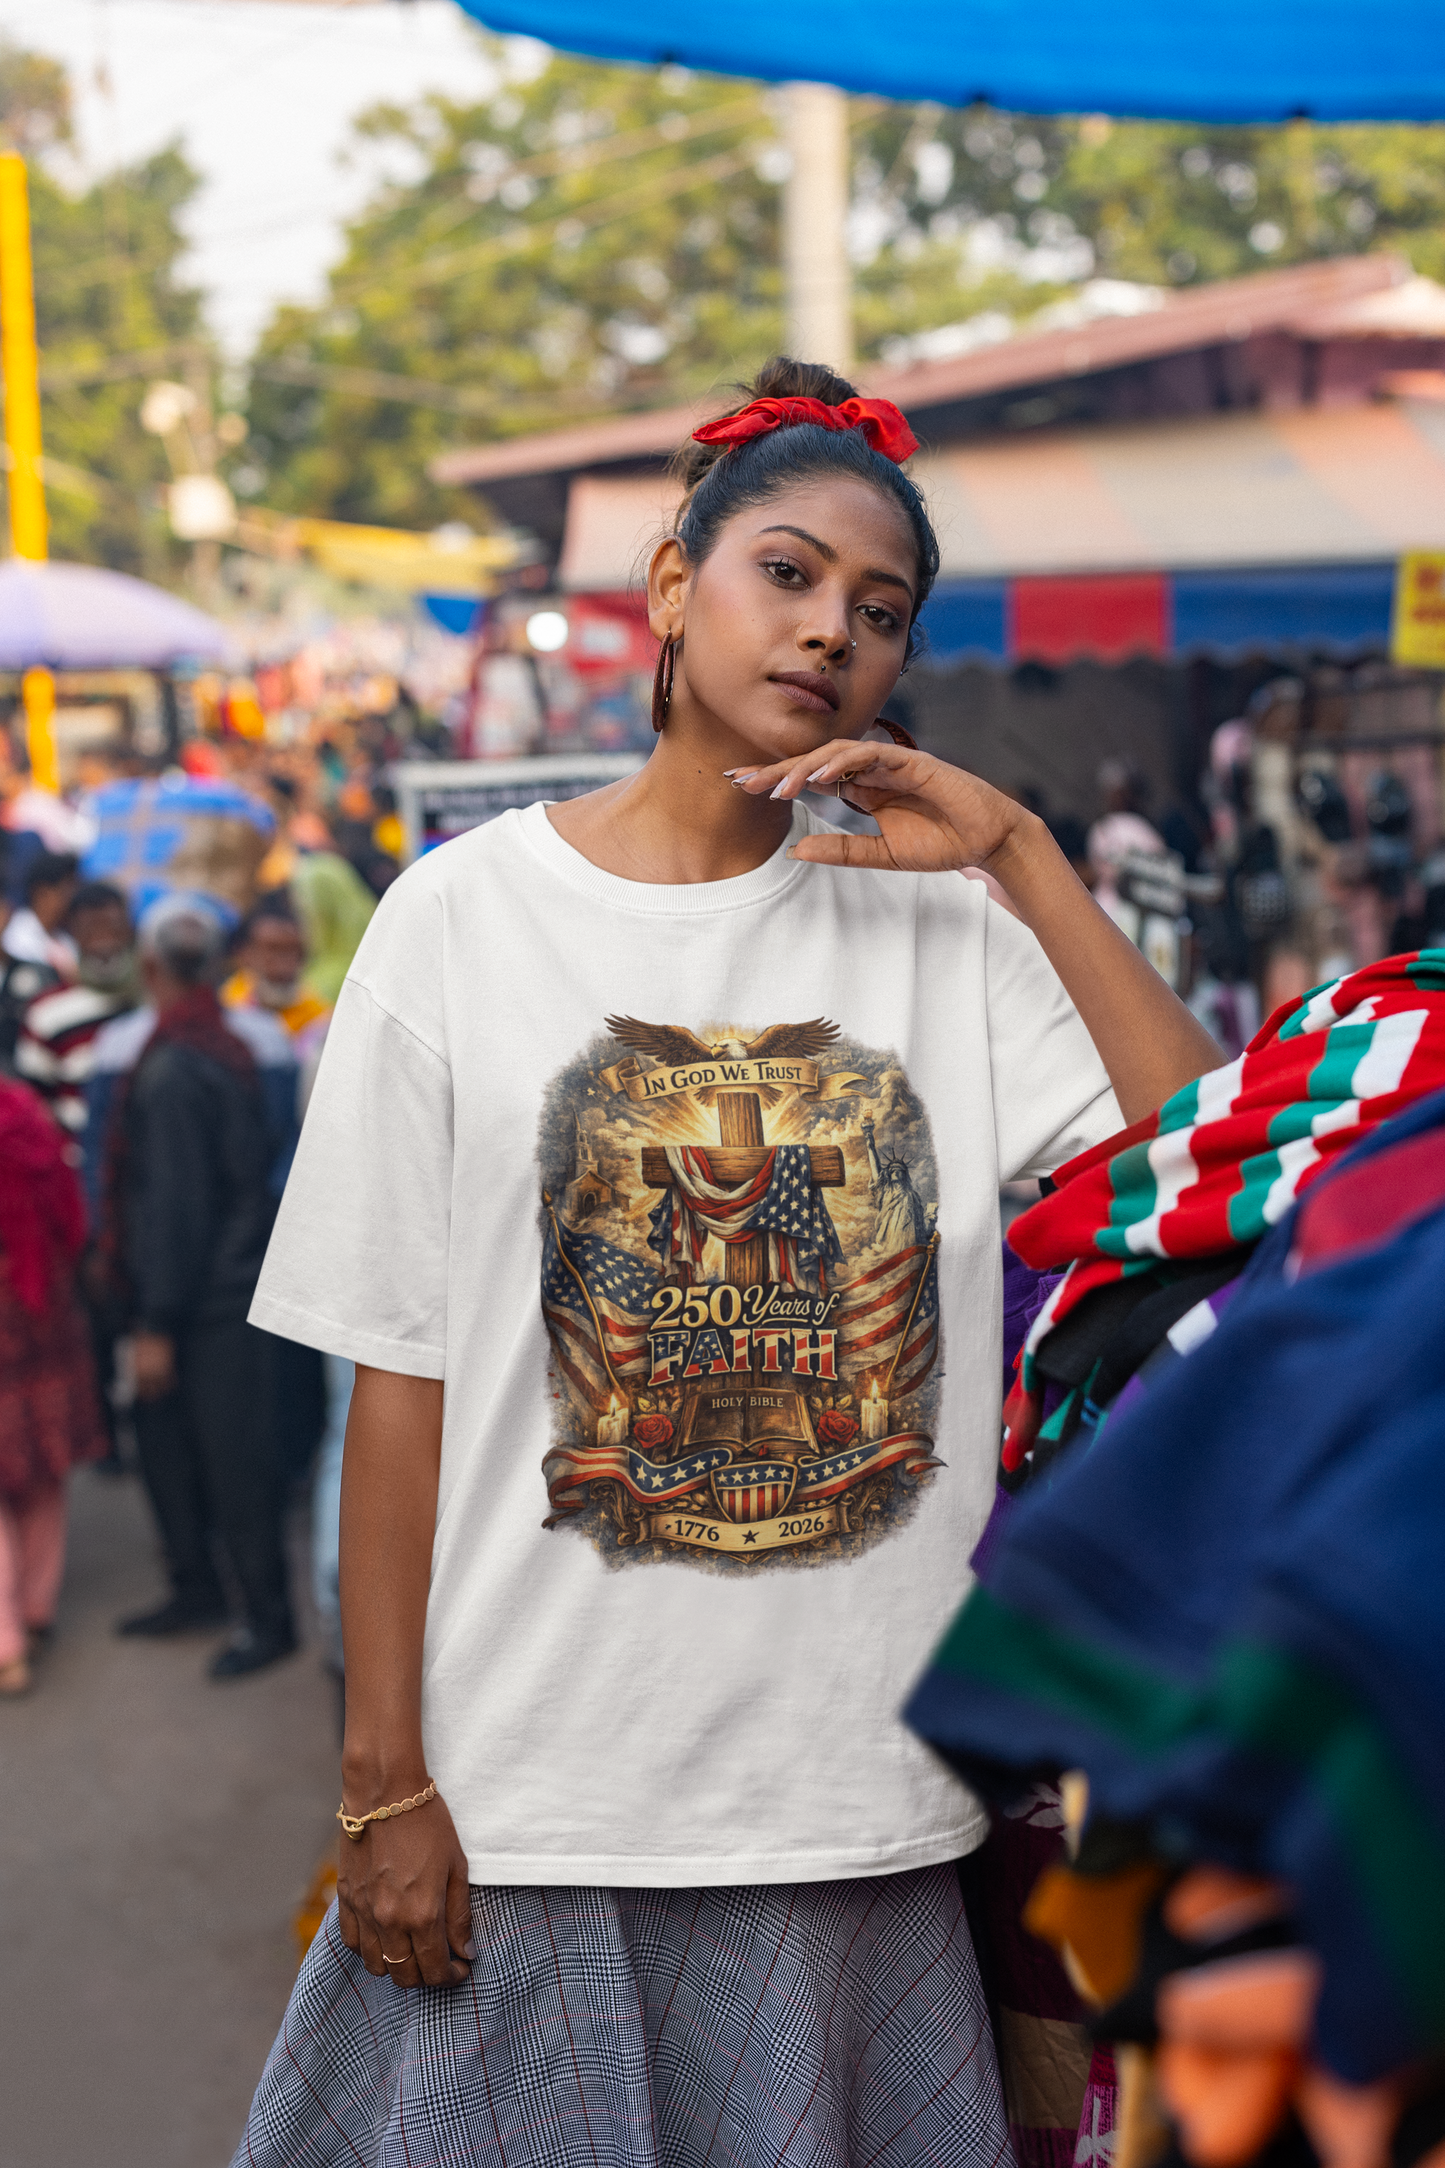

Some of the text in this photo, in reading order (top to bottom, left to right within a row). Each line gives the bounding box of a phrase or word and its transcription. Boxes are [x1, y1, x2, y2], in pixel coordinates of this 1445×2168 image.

[650, 1284, 840, 1329] 250 Years of
[647, 1328, 838, 1386] FAITH
[711, 1396, 784, 1410] HOLY BIBLE
[674, 1516, 825, 1541] 1776 2026
